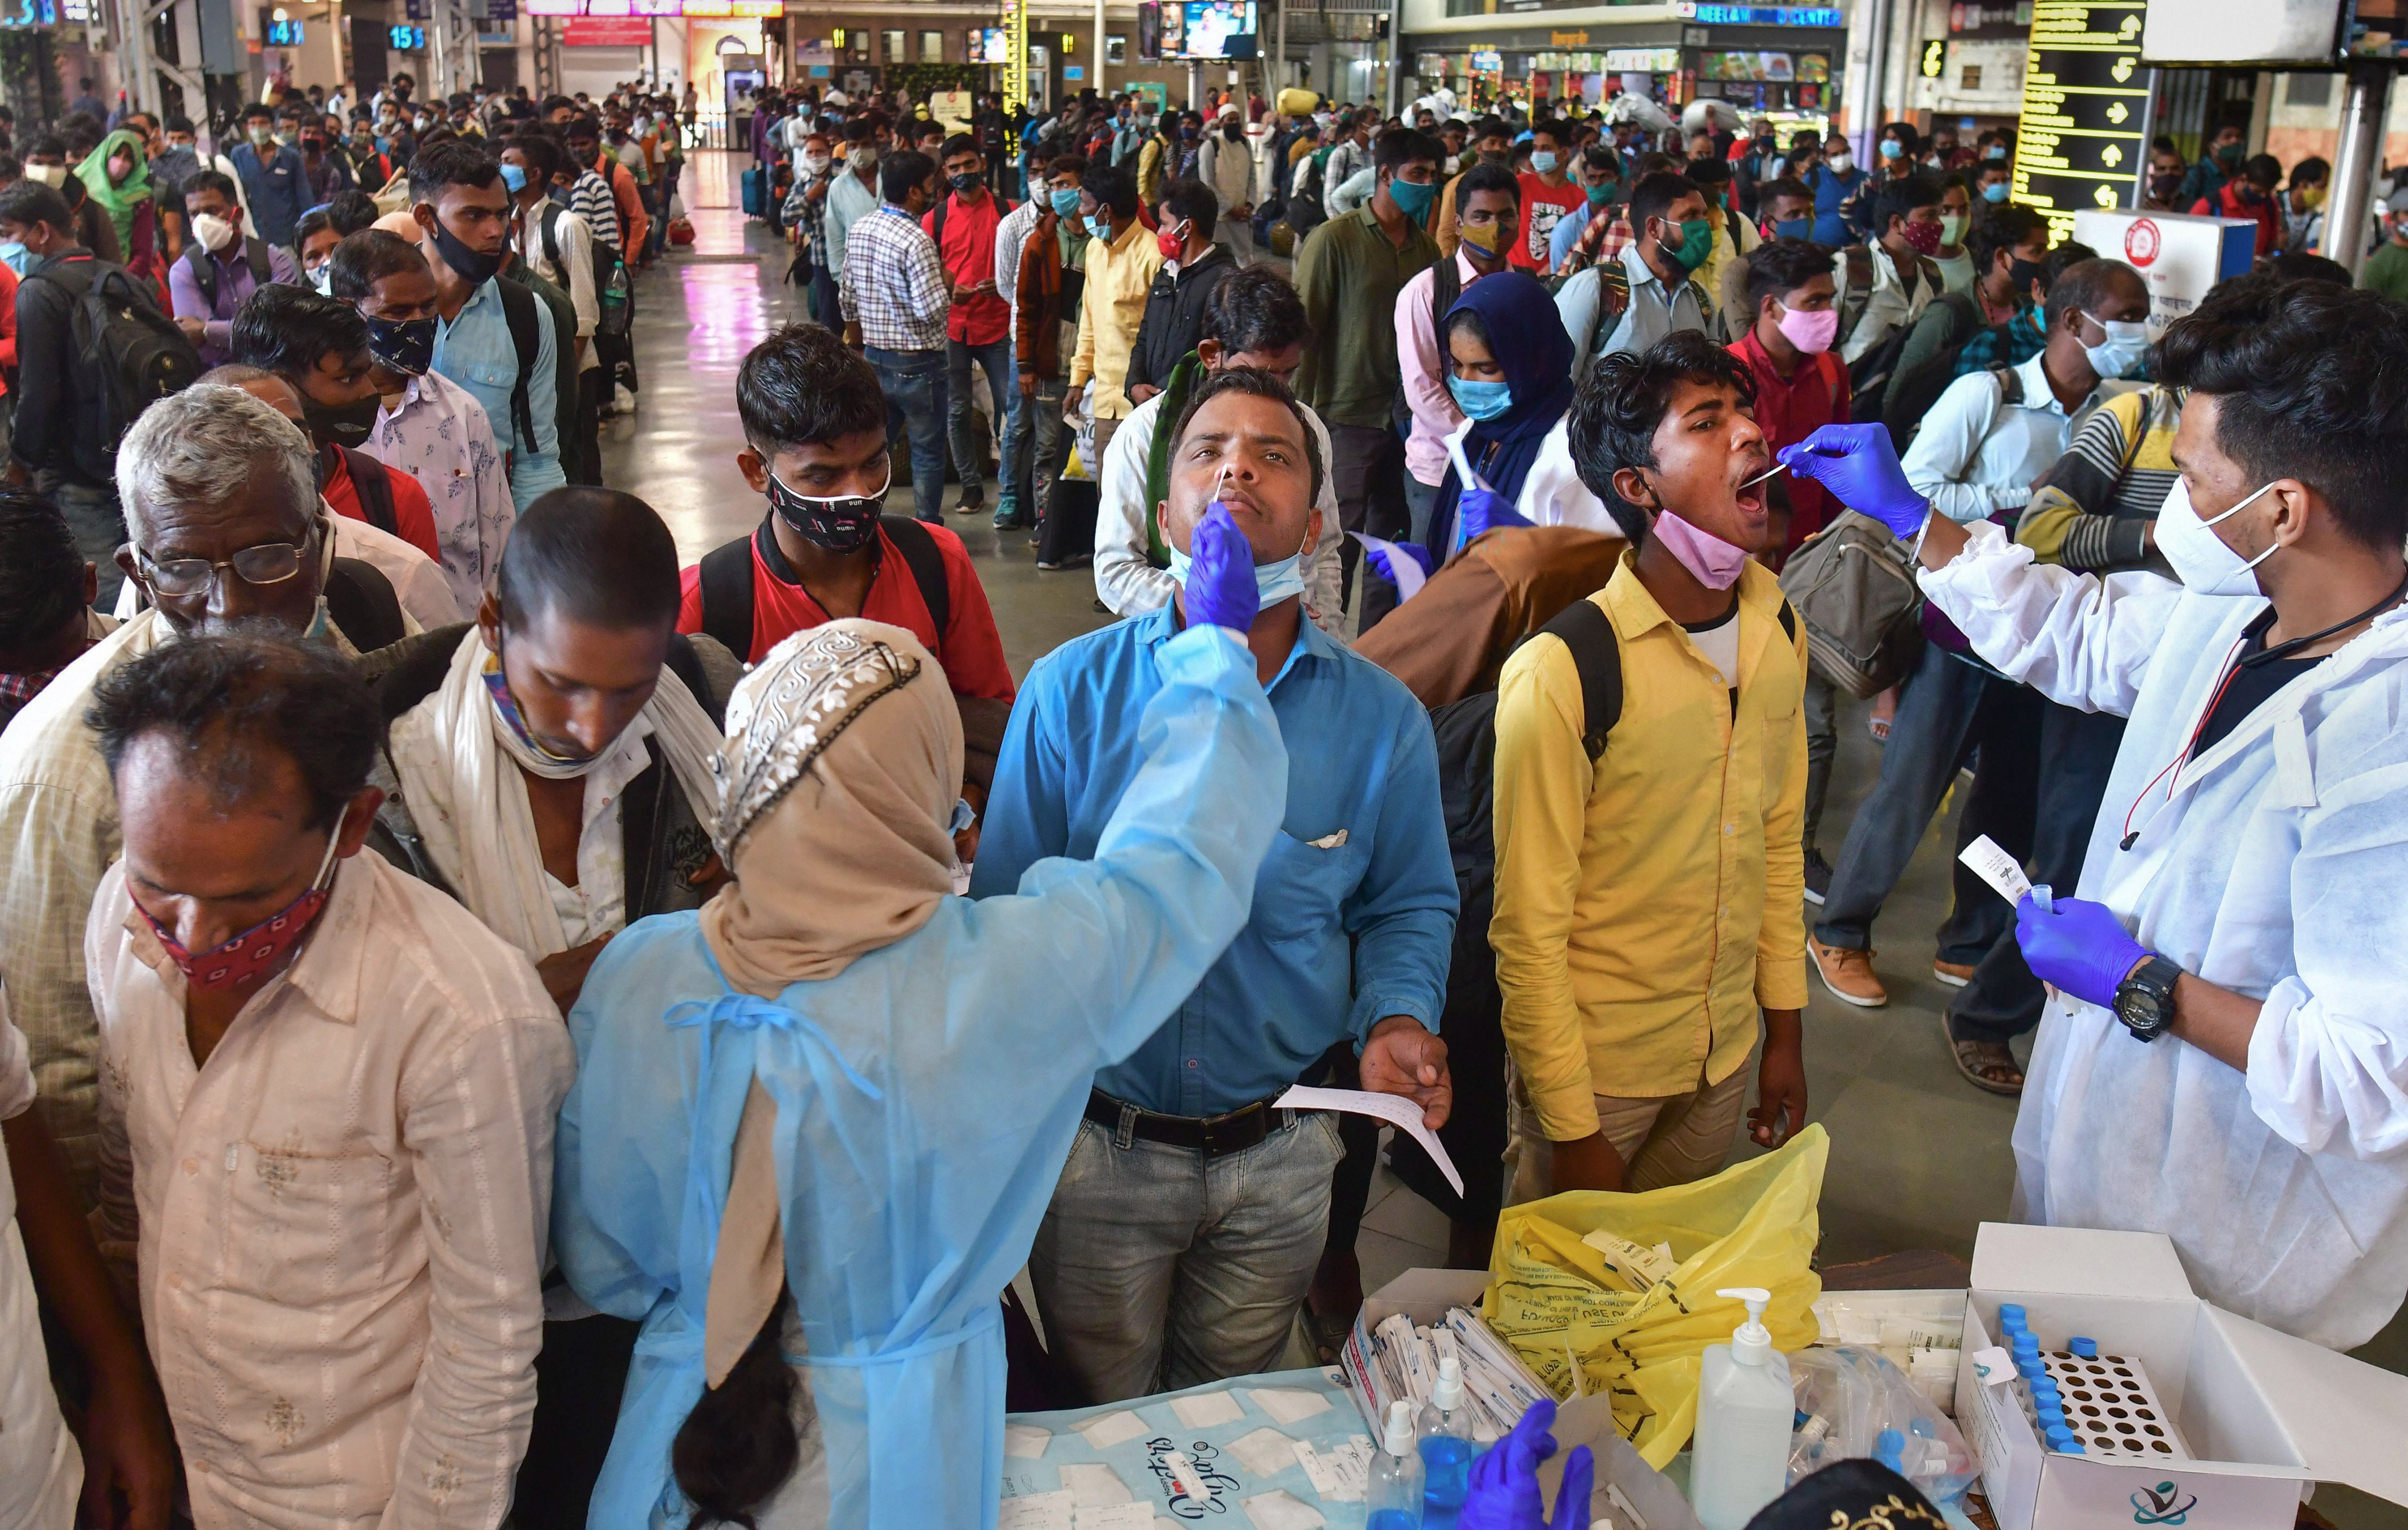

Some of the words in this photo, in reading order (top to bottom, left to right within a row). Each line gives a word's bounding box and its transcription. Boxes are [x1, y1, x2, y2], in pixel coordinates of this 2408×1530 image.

[390, 26, 412, 49] 15
[1532, 202, 1566, 217] NEVER
[1159, 1477, 1172, 1496] Happy
